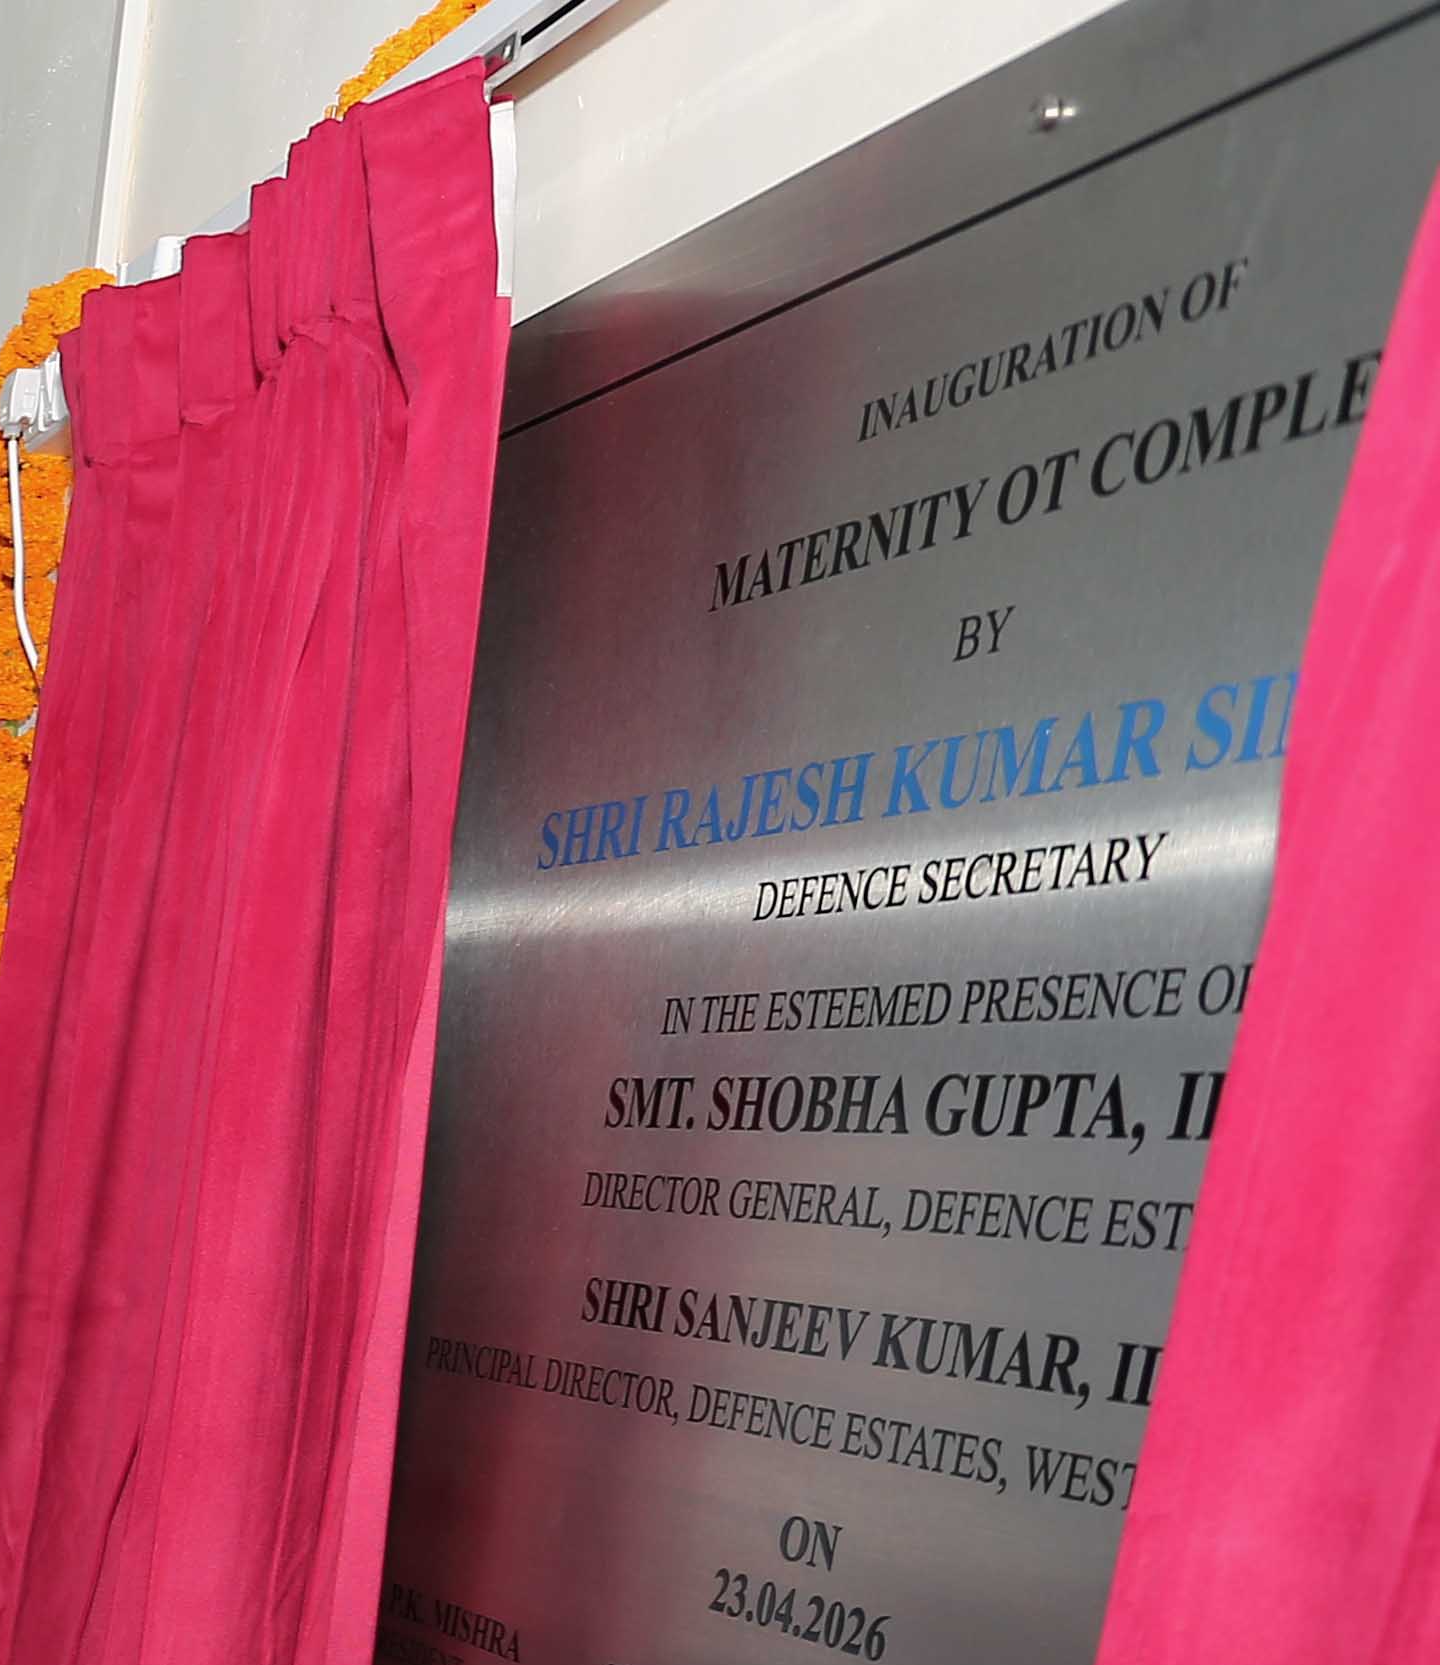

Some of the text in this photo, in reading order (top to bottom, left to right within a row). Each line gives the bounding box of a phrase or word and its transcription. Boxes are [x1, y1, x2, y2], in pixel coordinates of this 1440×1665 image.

[858, 258, 1248, 442] INAUGURATION OF
[708, 478, 989, 612] MATERNITY
[997, 448, 1080, 525] OT
[953, 606, 1015, 662] BY
[538, 671, 1298, 869] SHRI RAJESH KUMAR SI
[752, 832, 1169, 921] DEFENCE SECRETARY
[660, 997, 696, 1035] IN
[700, 993, 760, 1033] THE
[763, 982, 952, 1031] ESTEEMED
[958, 968, 1187, 1024] PRESENCE
[605, 1077, 696, 1130] SMT.
[706, 1075, 909, 1134] SHOBHA
[925, 1073, 1145, 1155] GUPTA,
[581, 1172, 720, 1216] DIRECTOR
[729, 1180, 891, 1238] GENERAL,
[901, 1189, 1093, 1244] DEFENCE
[581, 1277, 672, 1332] SHRI
[673, 1289, 870, 1360] SANJEEV
[872, 1313, 1090, 1410] KUMAR,
[426, 1336, 537, 1388] PRINCIPAL
[543, 1359, 679, 1426] DIRECTOR,
[686, 1384, 836, 1449] DEFENCE
[840, 1412, 1007, 1494] ESTATES,
[780, 1516, 843, 1571] ON
[432, 1599, 520, 1664] MISHRA
[708, 1568, 891, 1661] 23.04.2026
